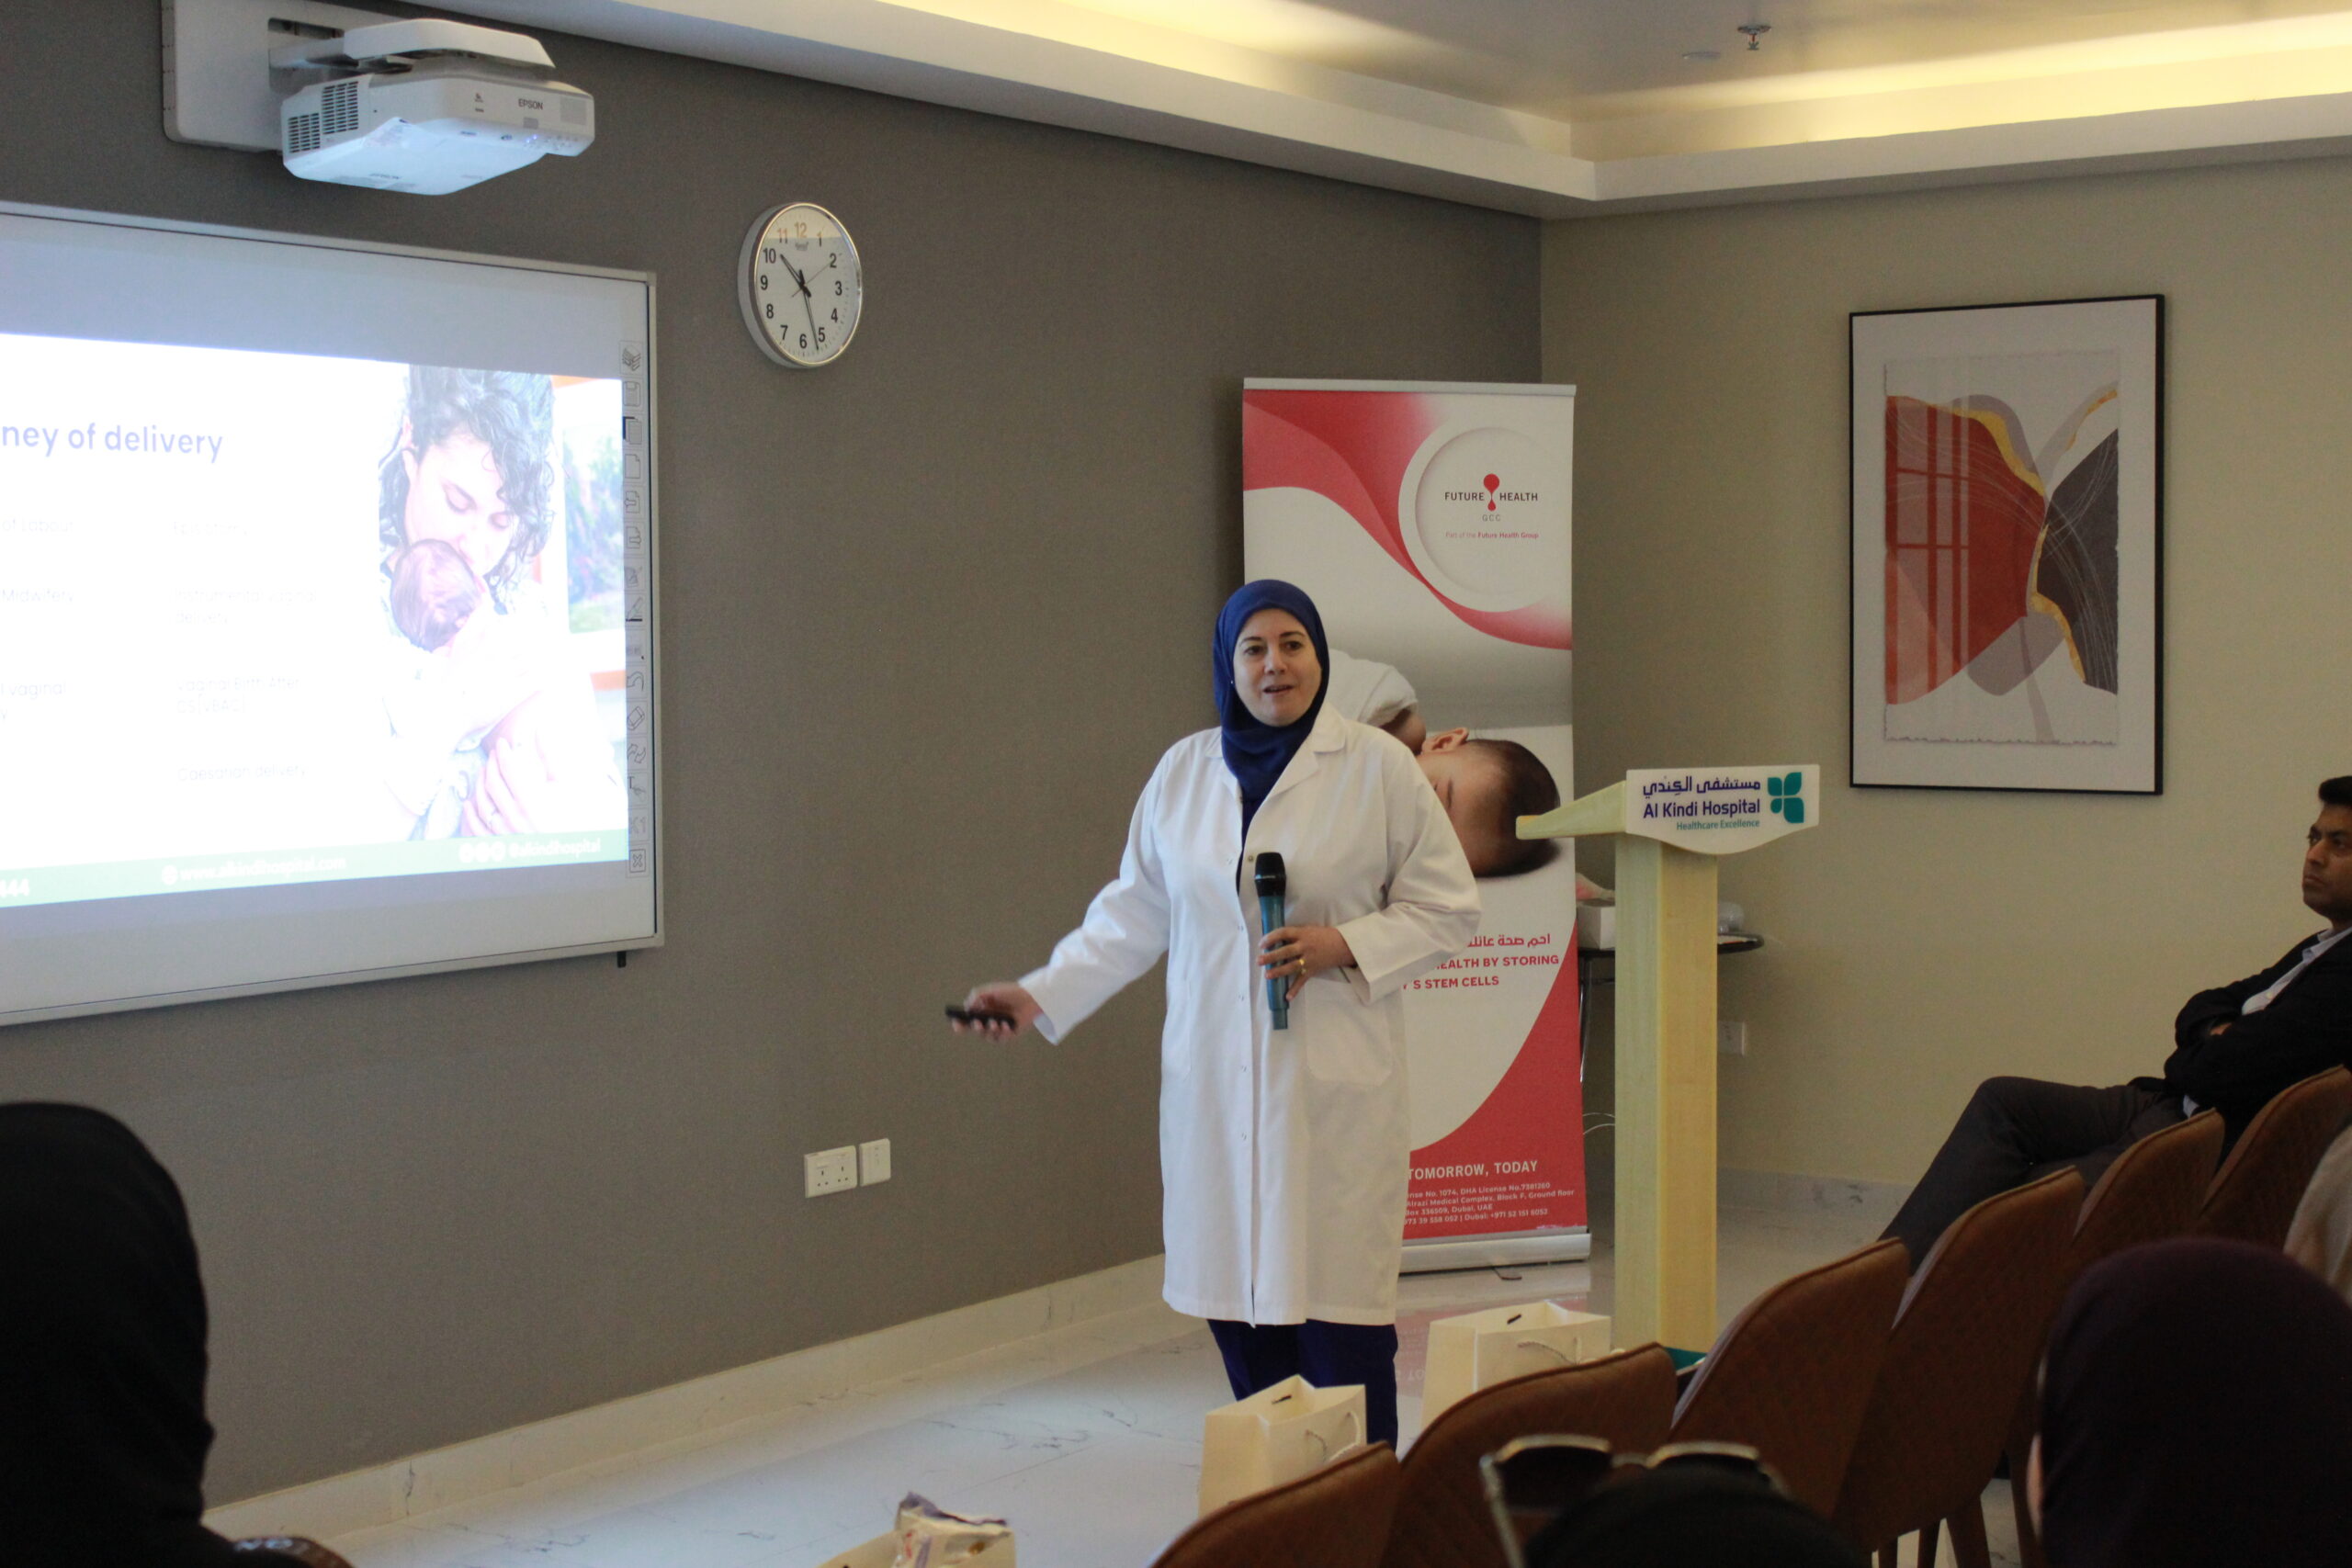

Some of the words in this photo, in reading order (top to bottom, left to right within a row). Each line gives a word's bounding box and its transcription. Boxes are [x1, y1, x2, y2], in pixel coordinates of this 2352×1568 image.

[518, 98, 544, 110] EPSON
[794, 221, 808, 238] 12
[817, 231, 822, 247] 1
[763, 248, 776, 264] 10
[830, 253, 837, 268] 2
[760, 275, 768, 290] 9
[835, 281, 842, 296] 3
[766, 304, 774, 319] 8
[831, 308, 838, 322] 4
[780, 325, 788, 340] 7
[818, 327, 825, 342] 5
[799, 333, 807, 348] 6
[3, 425, 59, 457] ney
[68, 422, 96, 449] of
[105, 424, 223, 464] delivery
[1444, 491, 1485, 502] FUTURE
[1499, 491, 1539, 502] HEALTH
[1521, 532, 1539, 540] Group
[1696, 776, 1761, 794] مستشفى
[1643, 803, 1657, 818] Al
[1663, 801, 1698, 818] Kindi
[1702, 798, 1760, 818] Hospital
[1676, 820, 1719, 830] Healthcare
[1720, 818, 1759, 829] Excellence
[1498, 934, 1525, 947] صحة
[1527, 933, 1551, 948] احم
[1437, 958, 1479, 969] EALTH
[1483, 957, 1499, 967] BY
[1502, 954, 1559, 966] STORING
[1425, 978, 1458, 989] STEM
[1462, 976, 1499, 987] CELLS
[1408, 1163, 1489, 1180] TOMORROW,
[1494, 1160, 1537, 1174] TODAY
[1430, 1197, 1459, 1205] Medical
[1497, 1192, 1518, 1201] Block
[1528, 1190, 1556, 1199] Ground
[1557, 1189, 1575, 1197] floor
[1460, 1187, 1476, 1195] DHA
[1477, 1203, 1493, 1212] UAE
